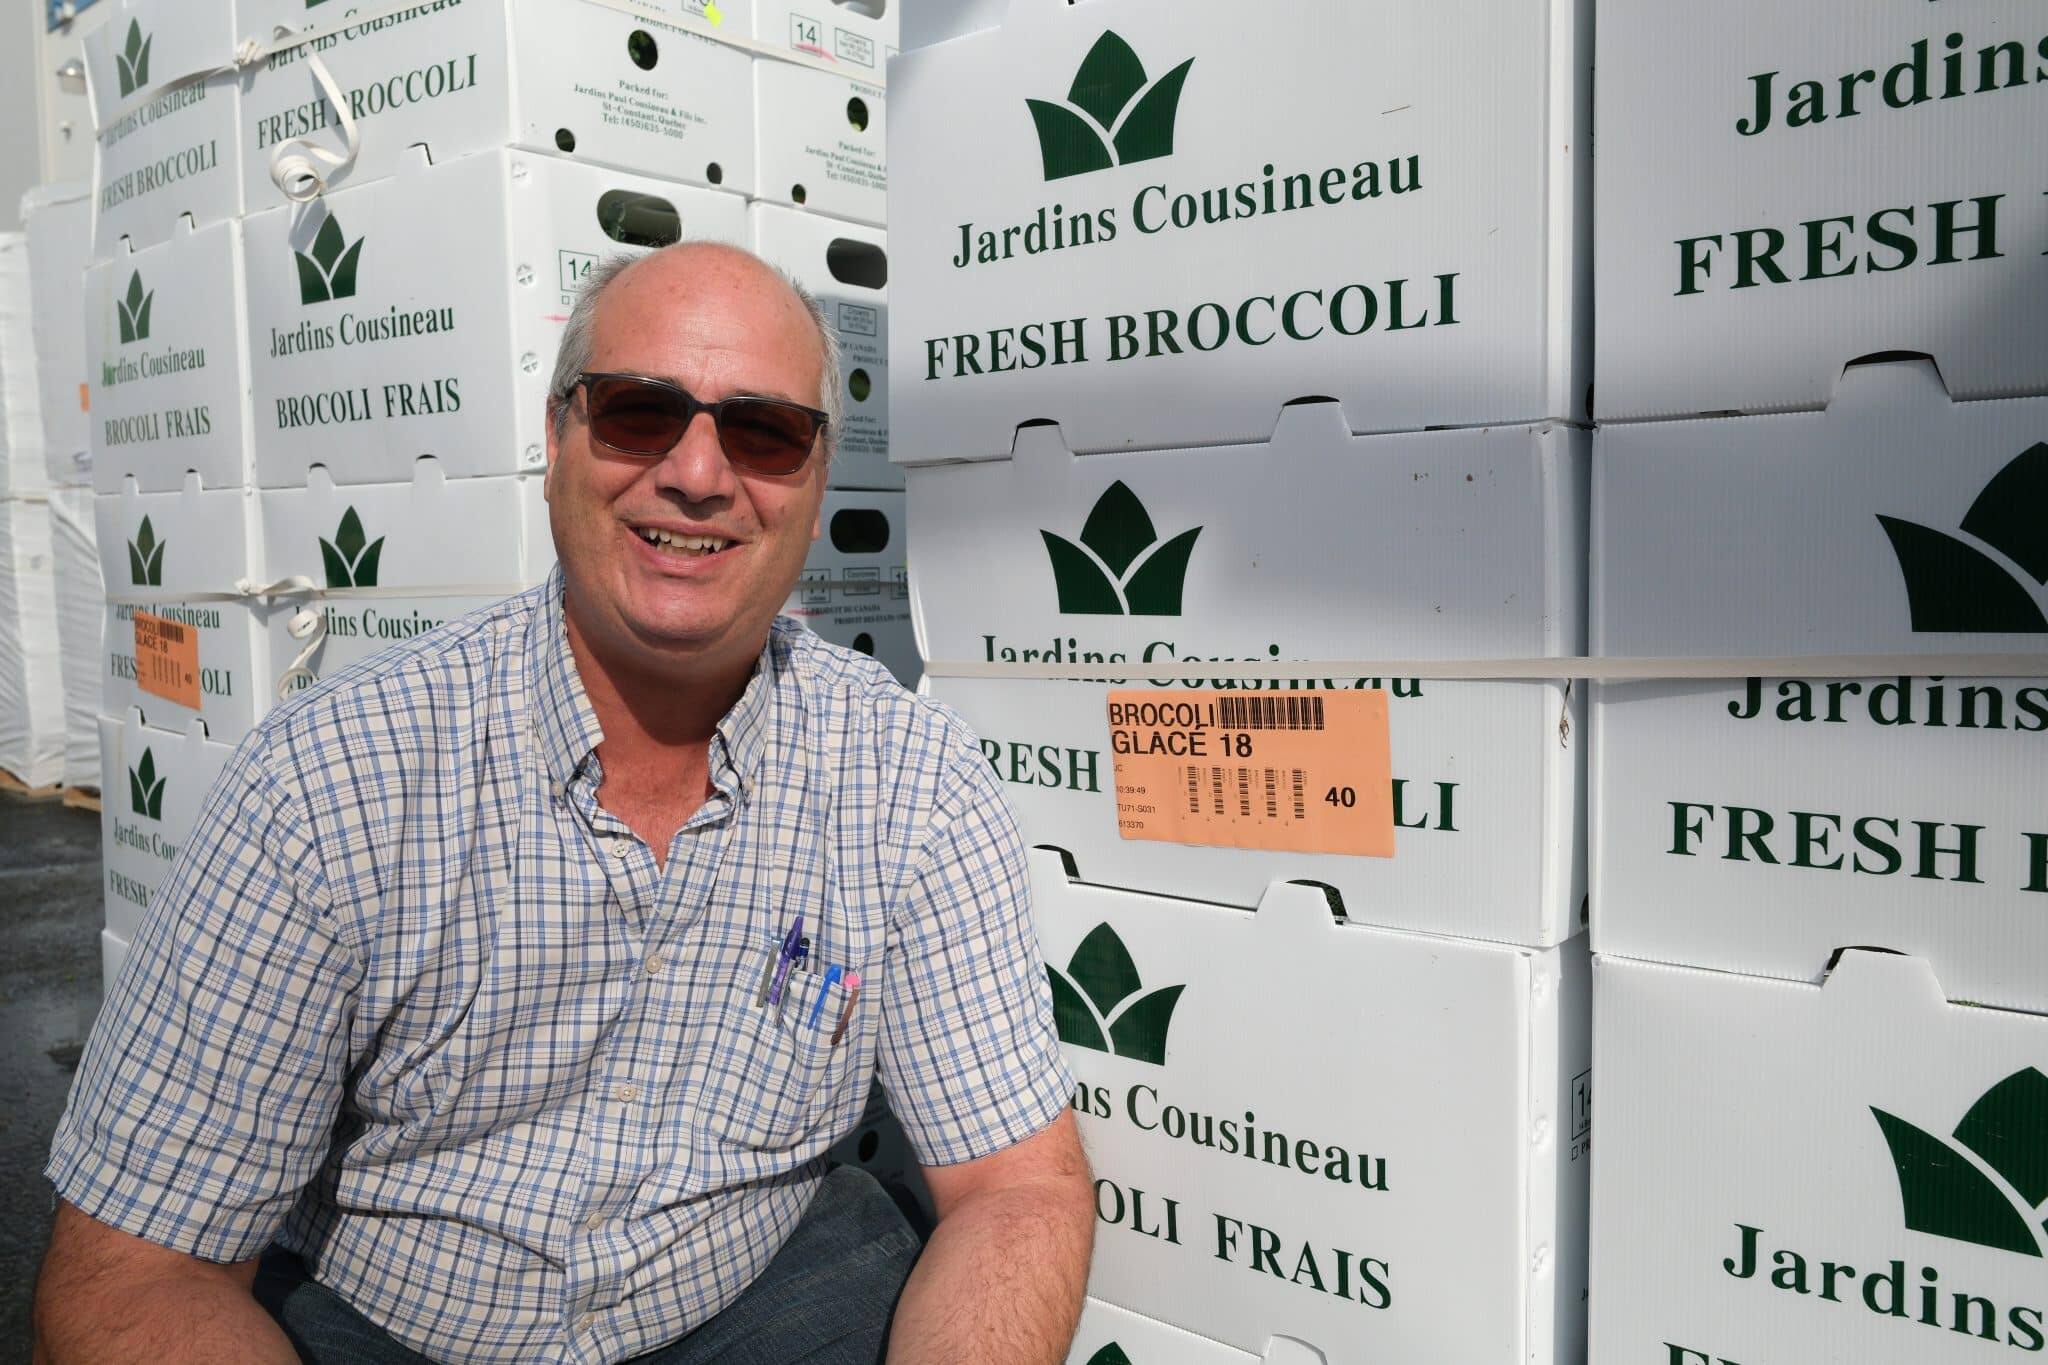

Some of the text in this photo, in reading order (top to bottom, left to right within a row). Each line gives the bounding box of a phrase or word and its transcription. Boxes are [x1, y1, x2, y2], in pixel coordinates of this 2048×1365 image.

[797, 22, 816, 45] 14
[1736, 32, 2048, 137] Jardin
[257, 99, 327, 150] FRESH
[136, 140, 217, 196] BROCCOLI
[953, 154, 1423, 268] Jardins Cousineau
[1673, 194, 2006, 295] FRESH
[271, 305, 454, 358] Jardins Cousineau
[924, 273, 1461, 381] FRESH BROCCOLI
[141, 345, 205, 378] Cousineau
[105, 405, 211, 446] BROCOLI FRAIS
[276, 378, 461, 429] BROCOLI FRAIS
[362, 608, 445, 640] Cousi
[111, 653, 139, 681] FRES
[1142, 641, 1424, 698] Cousinu
[1110, 703, 1216, 727] BROCOLI
[1727, 676, 2048, 732] Jardins
[979, 738, 1102, 793] RESH
[1219, 733, 1253, 758] 18
[1325, 787, 1357, 808] 40
[114, 816, 150, 853] Jardins
[1666, 801, 1986, 883] FRESH
[111, 869, 148, 908] FRESH
[1127, 1084, 1390, 1191] Cousineau
[1214, 1213, 1393, 1310] FRAIS
[1723, 1224, 2045, 1352] Jardins
